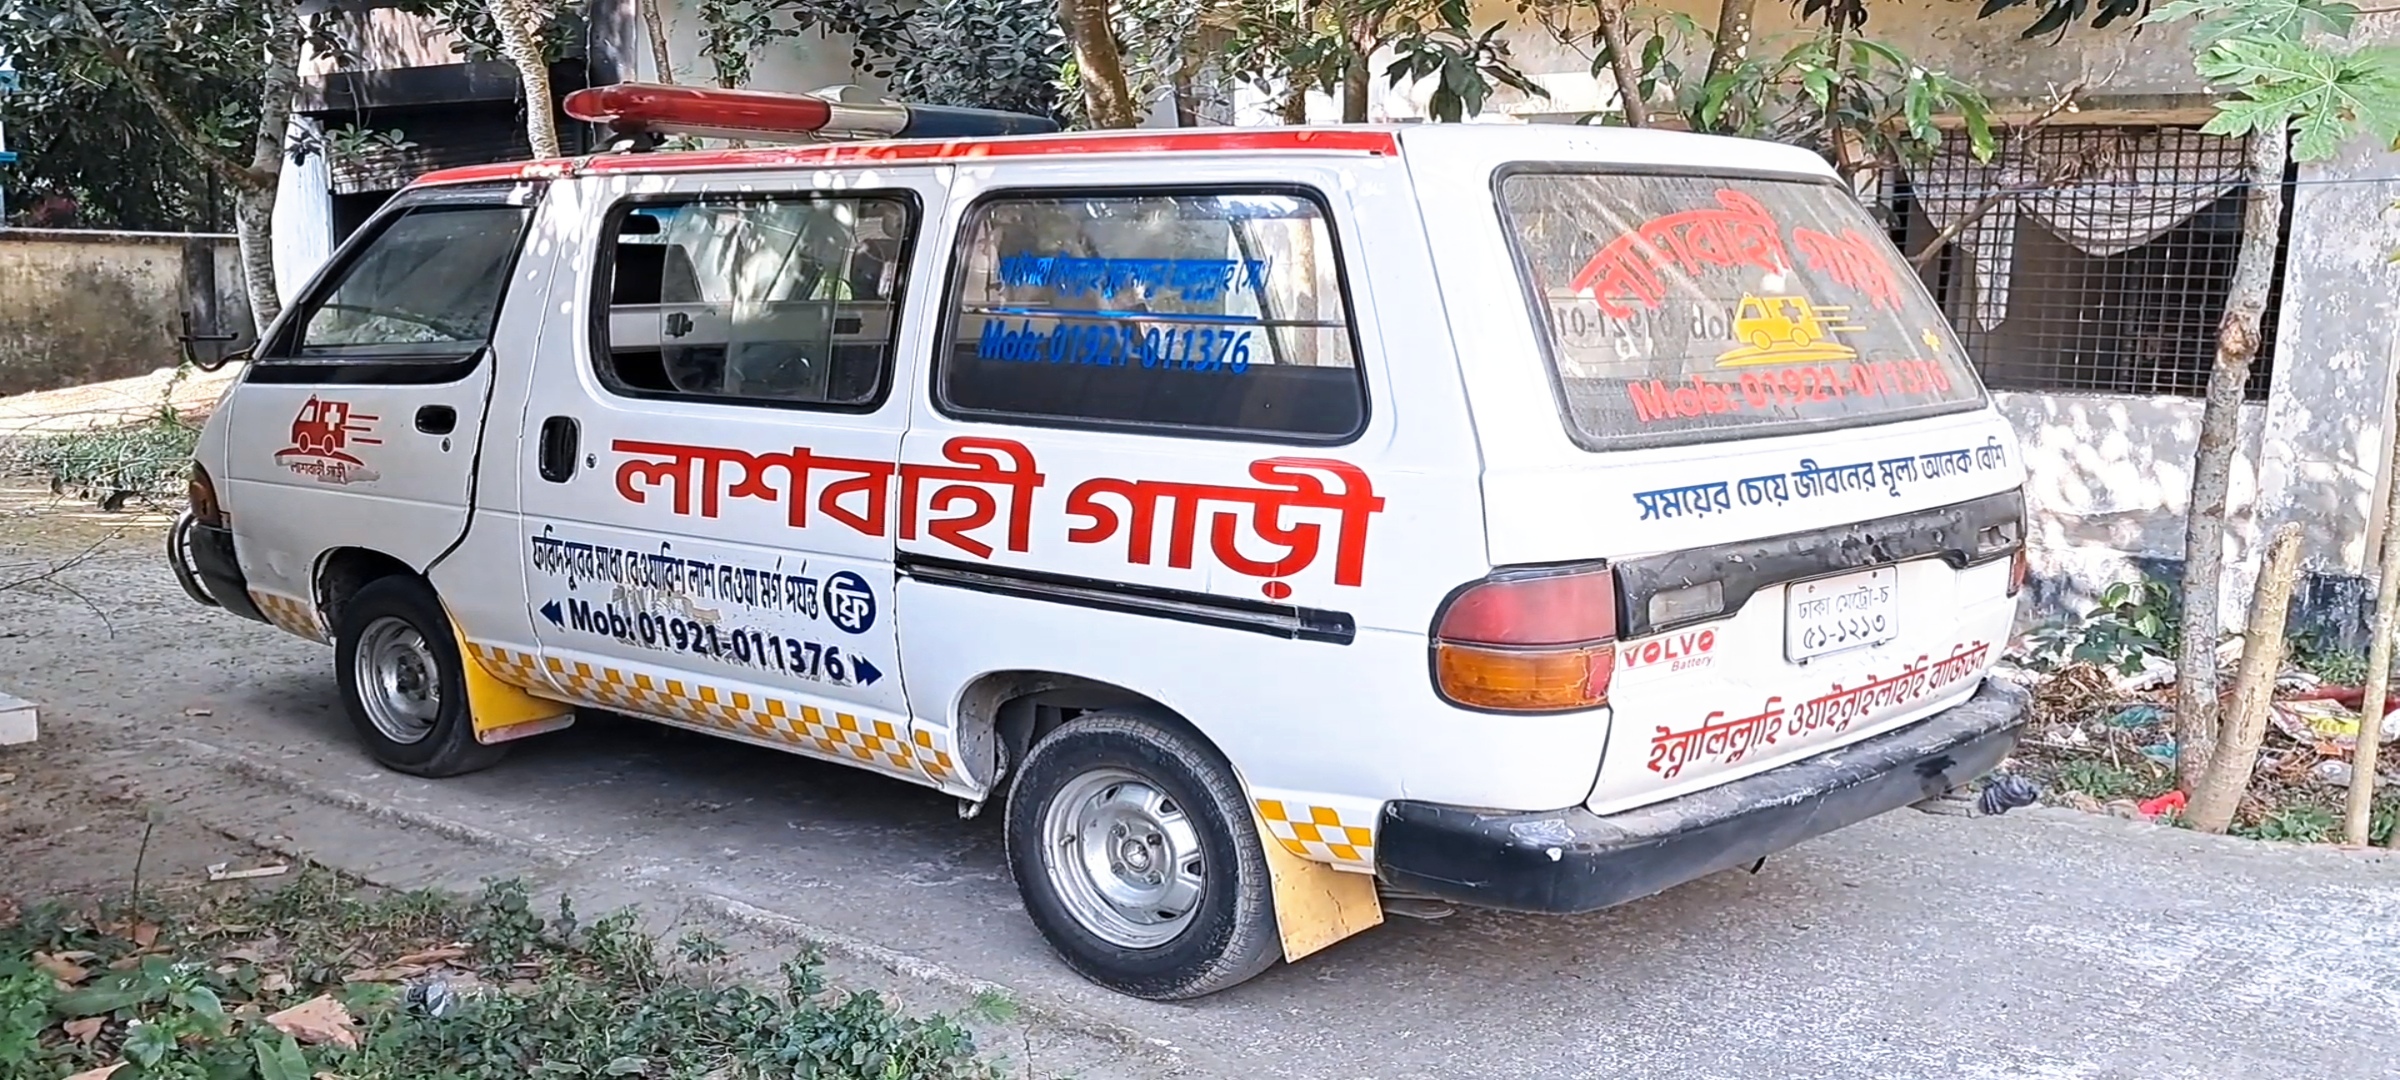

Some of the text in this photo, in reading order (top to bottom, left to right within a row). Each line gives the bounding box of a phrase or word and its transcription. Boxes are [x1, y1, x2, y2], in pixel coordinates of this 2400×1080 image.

[1569, 188, 1792, 318] লাশবাহী
[977, 319, 1253, 374] Mob: 01921-011376
[1627, 359, 1952, 422] Mob: 01921-011376
[1634, 435, 2007, 522] সময়ের চেয়ে জীবনের মূল্য অনেক বেশি
[612, 435, 1386, 598] লাশবাহী গাড়ী
[687, 559, 716, 600] লাশ
[718, 564, 758, 612] নেওয়া
[759, 555, 784, 611] মর্গ
[785, 559, 819, 621] পর্যন্ত
[1798, 596, 1831, 619] ঢাকা
[567, 597, 847, 682] Mob: 01921-011376
[1624, 630, 1715, 668] VOLVO
[1803, 614, 1886, 650] ৫১-১২১৩
[1671, 655, 1713, 673] Battery
